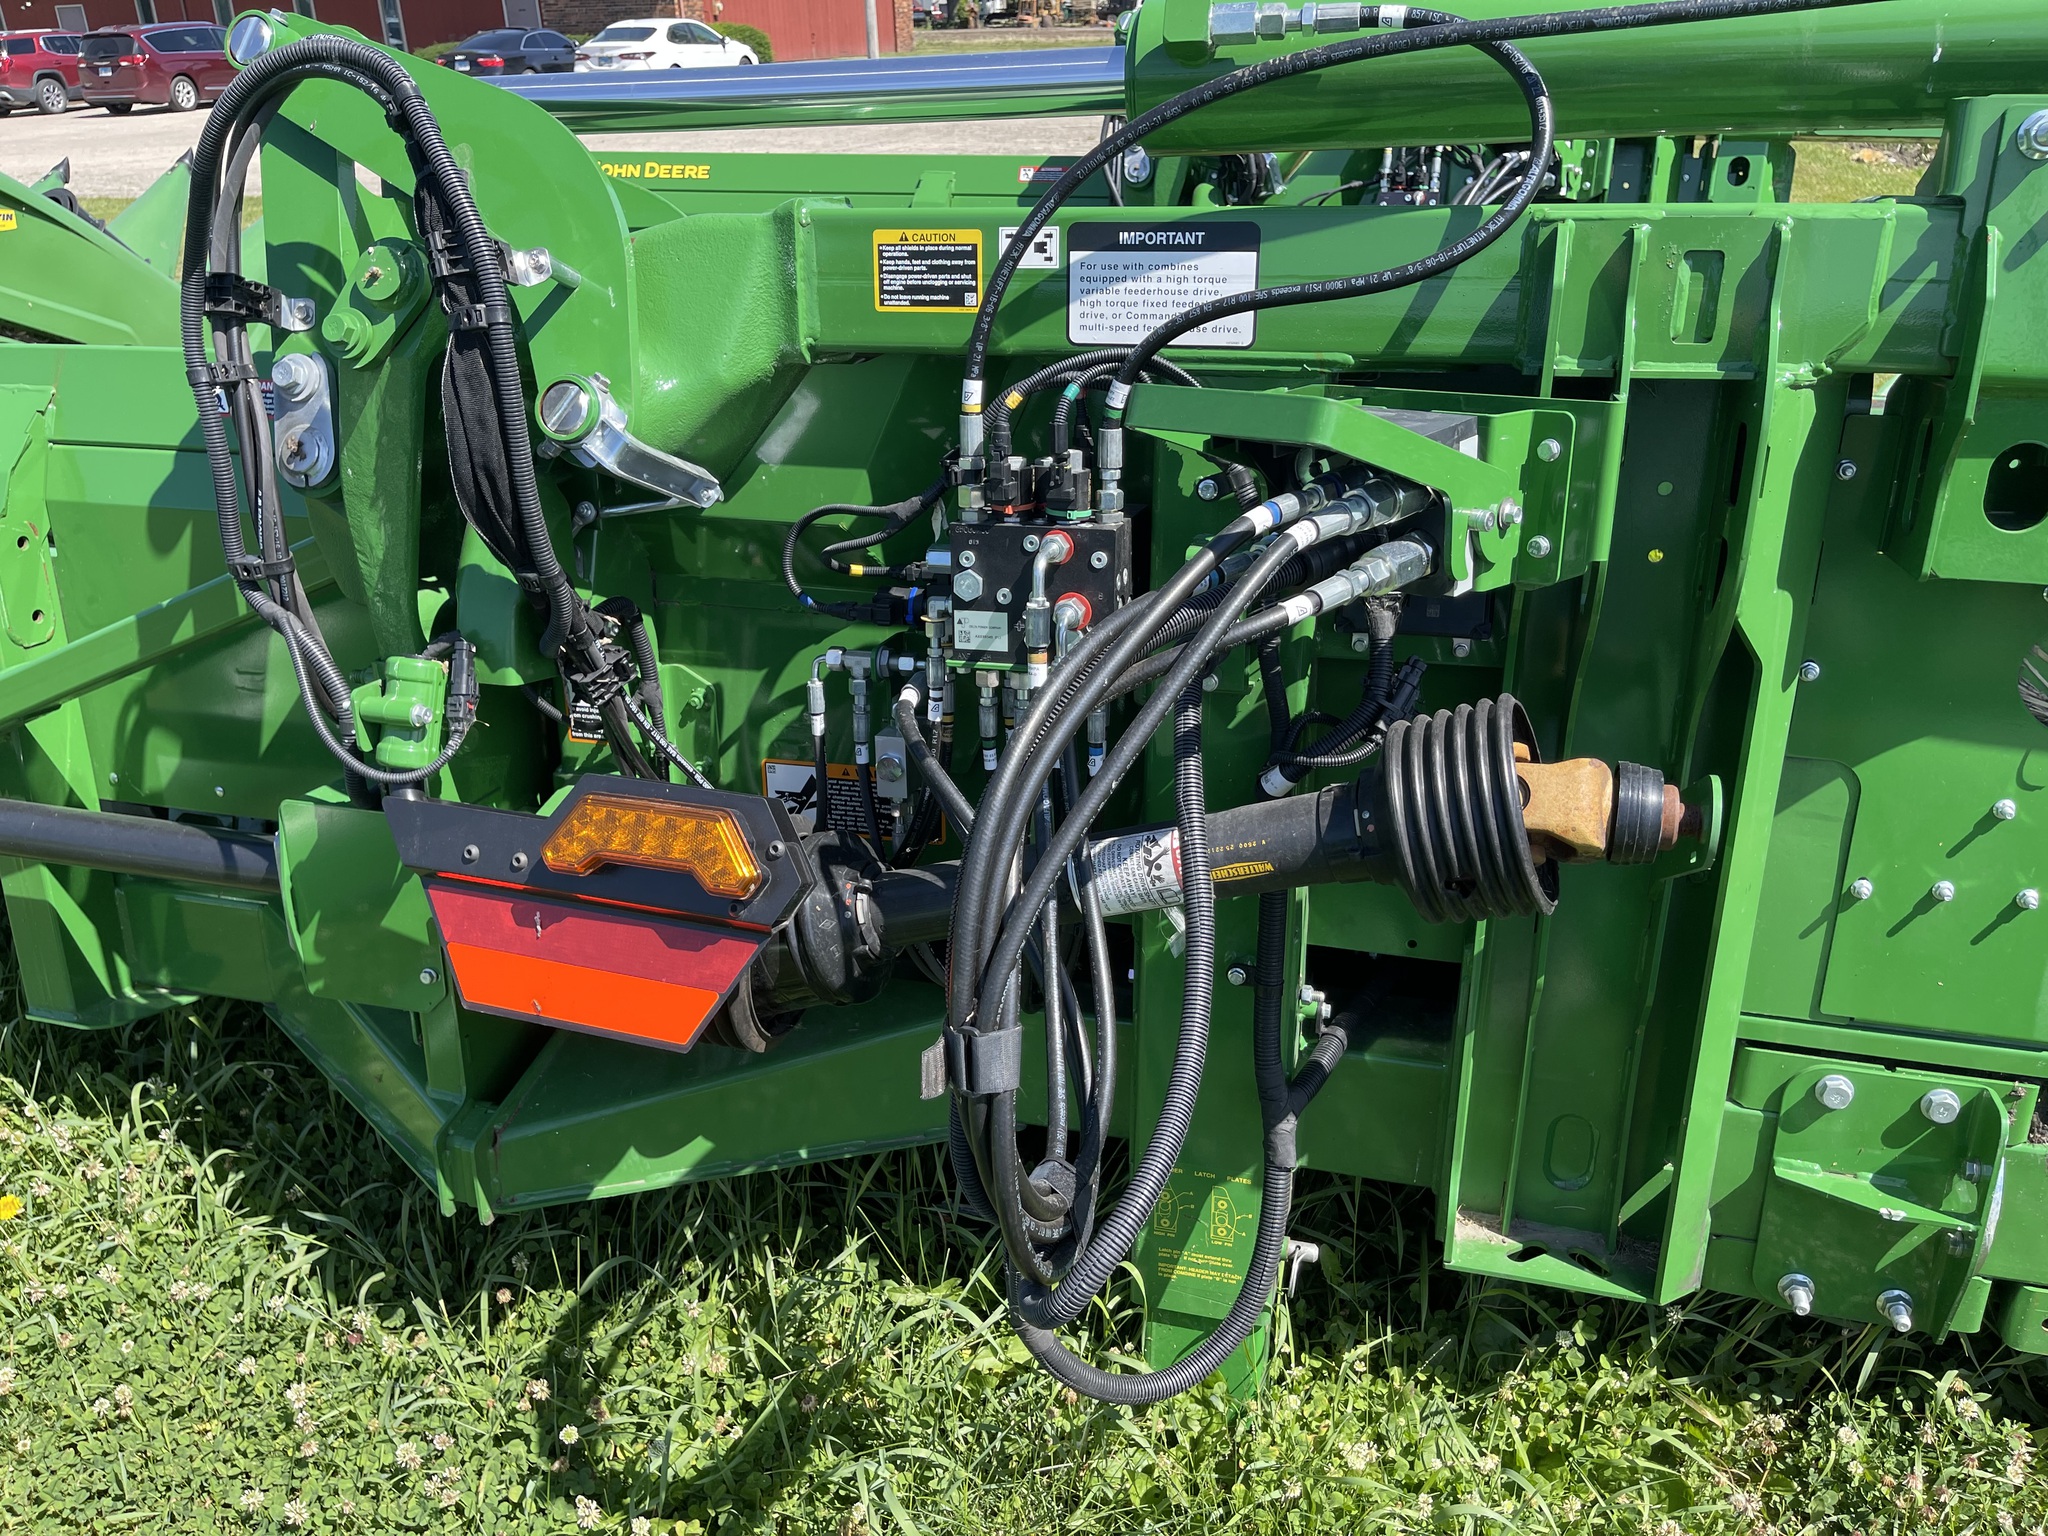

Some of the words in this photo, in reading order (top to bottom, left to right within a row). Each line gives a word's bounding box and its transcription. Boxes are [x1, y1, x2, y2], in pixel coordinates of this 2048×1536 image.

[598, 160, 641, 177] OHN
[644, 161, 710, 179] DEERE
[912, 233, 956, 242] CAUTION
[1119, 231, 1205, 245] IMPORTANT
[1080, 262, 1097, 271] For
[1101, 263, 1119, 271] use
[1123, 262, 1144, 271] with
[1148, 262, 1199, 271] combines
[1080, 275, 1127, 284] equipped
[1131, 275, 1152, 283] with
[1166, 275, 1189, 285] high
[1193, 276, 1227, 286] torque
[1080, 287, 1120, 295] variable
[1124, 287, 1189, 296] feederhouse
[1193, 288, 1223, 297] drive,
[1271, 286, 1301, 296] exceeds
[1080, 299, 1101, 309] high
[1105, 300, 1138, 309] torque
[1142, 299, 1168, 308] fixed
[1080, 311, 1108, 320] drive,
[1079, 323, 1139, 332] multi-speed
[1211, 325, 1241, 334] drive.
[1194, 1171, 1215, 1179] LATCH
[1226, 1175, 1251, 1185] PLATES
[1189, 1267, 1209, 1275] HEADER
